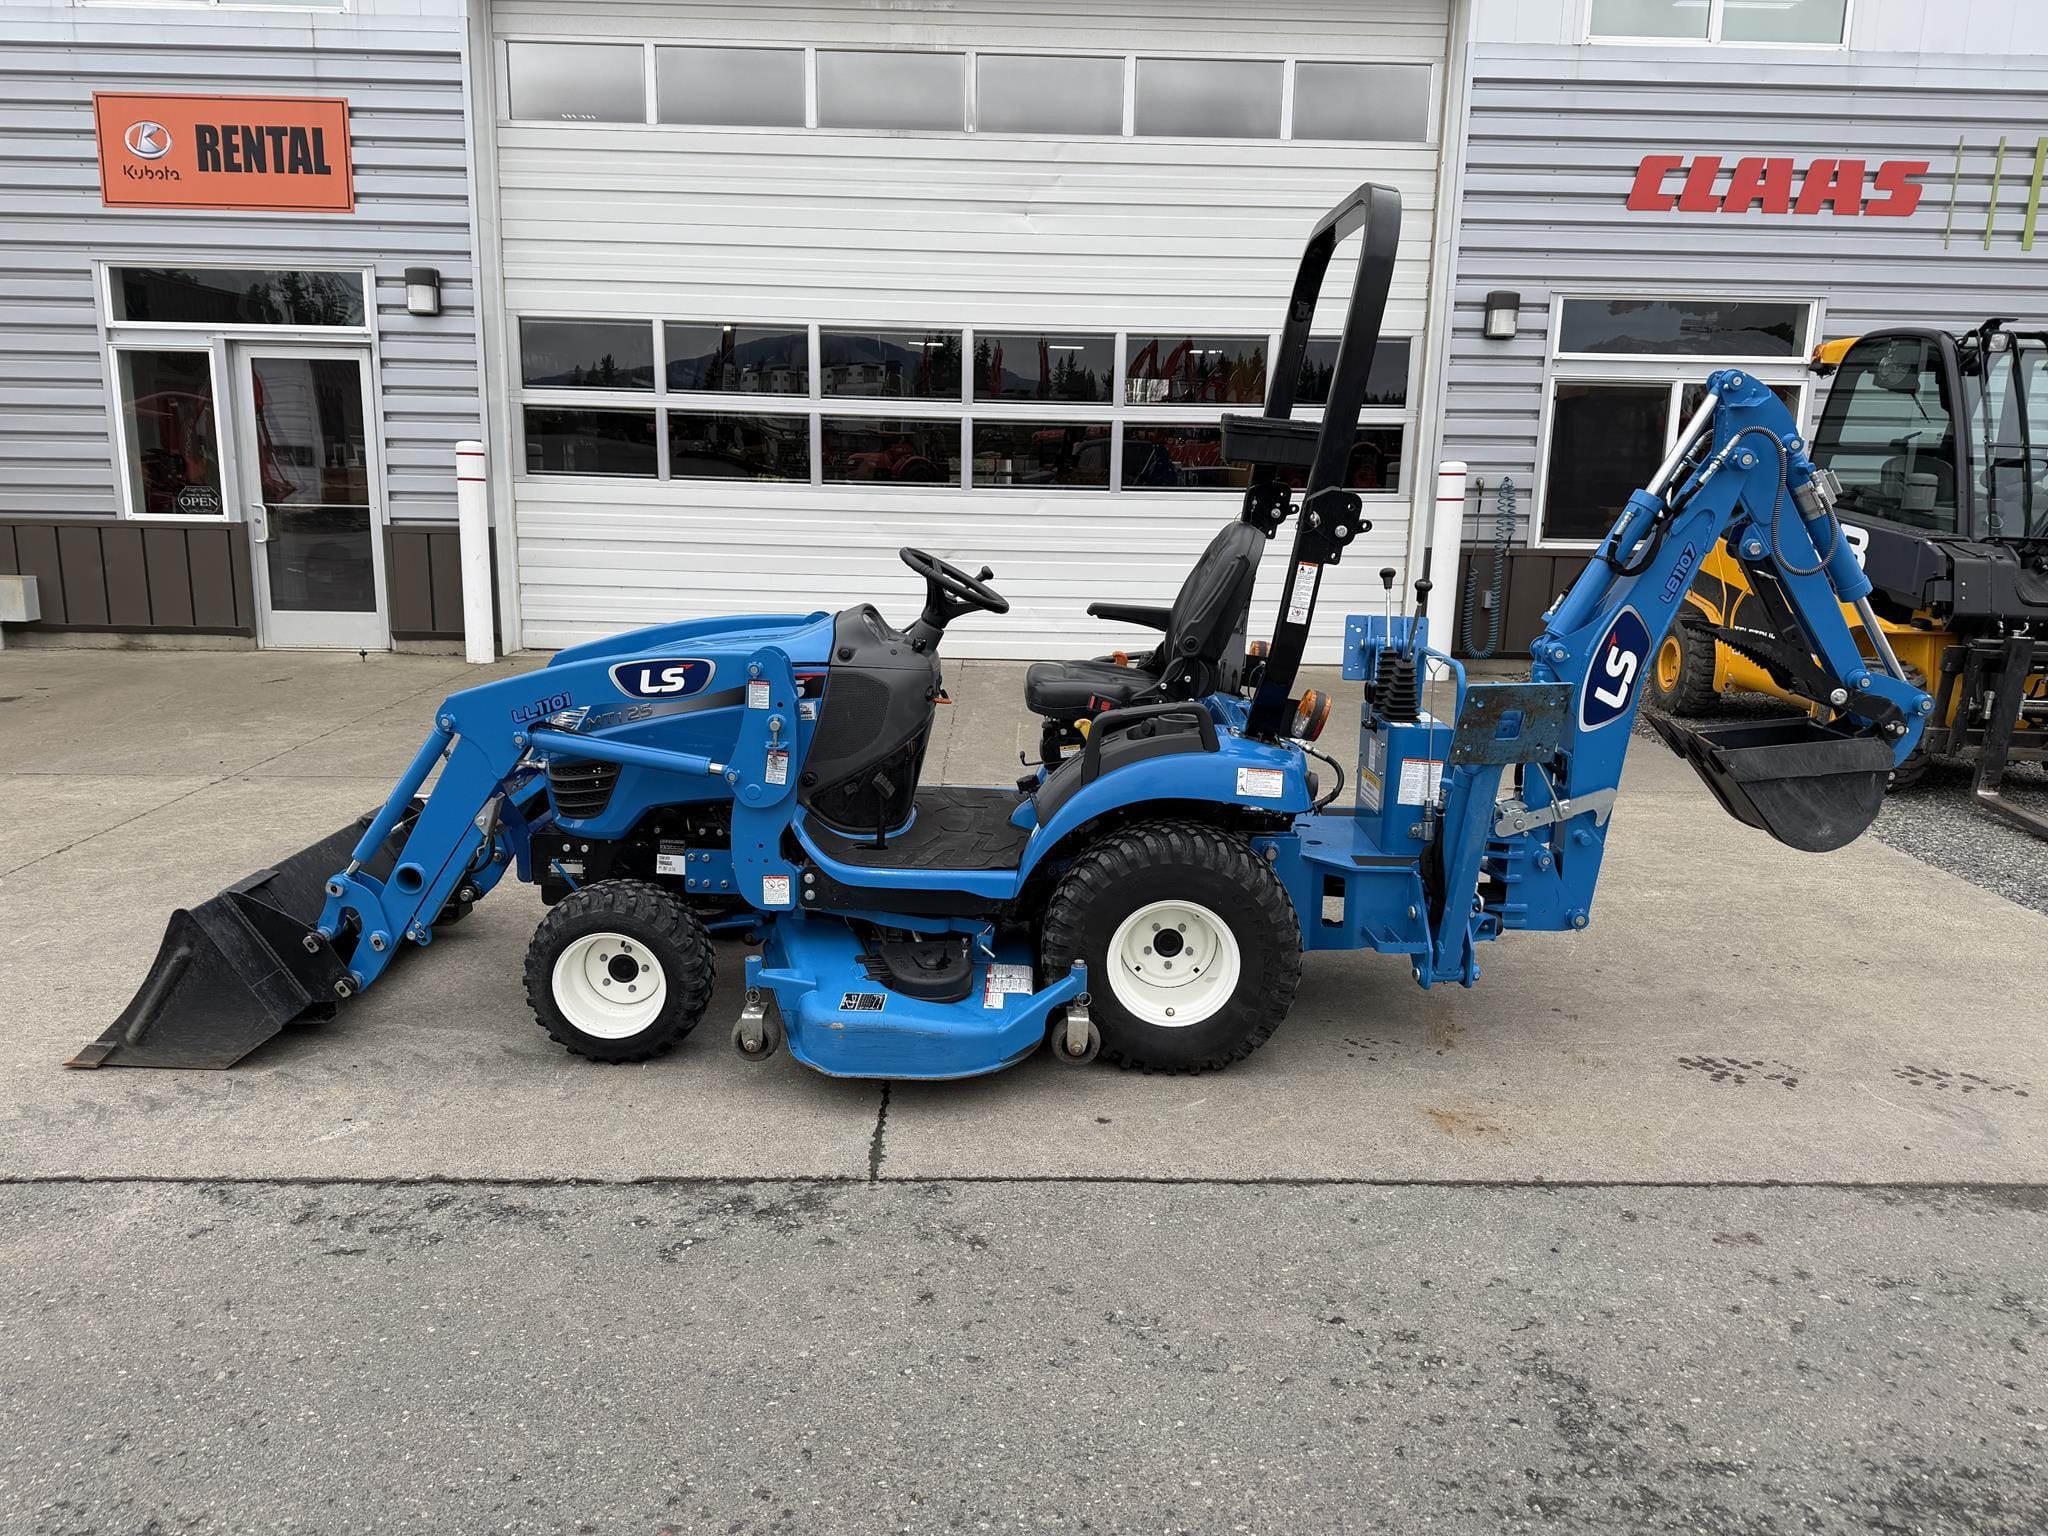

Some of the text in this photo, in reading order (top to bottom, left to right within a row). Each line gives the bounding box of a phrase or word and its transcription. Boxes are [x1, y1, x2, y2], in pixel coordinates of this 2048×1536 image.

[195, 124, 332, 175] RENTAL
[123, 165, 181, 181] Kubota
[1626, 155, 1930, 217] CLAAS
[180, 496, 218, 507] OPEN
[1659, 541, 1697, 604] LB1107
[639, 666, 686, 694] LS
[1594, 645, 1638, 709] LS
[511, 691, 573, 724] LL1101
